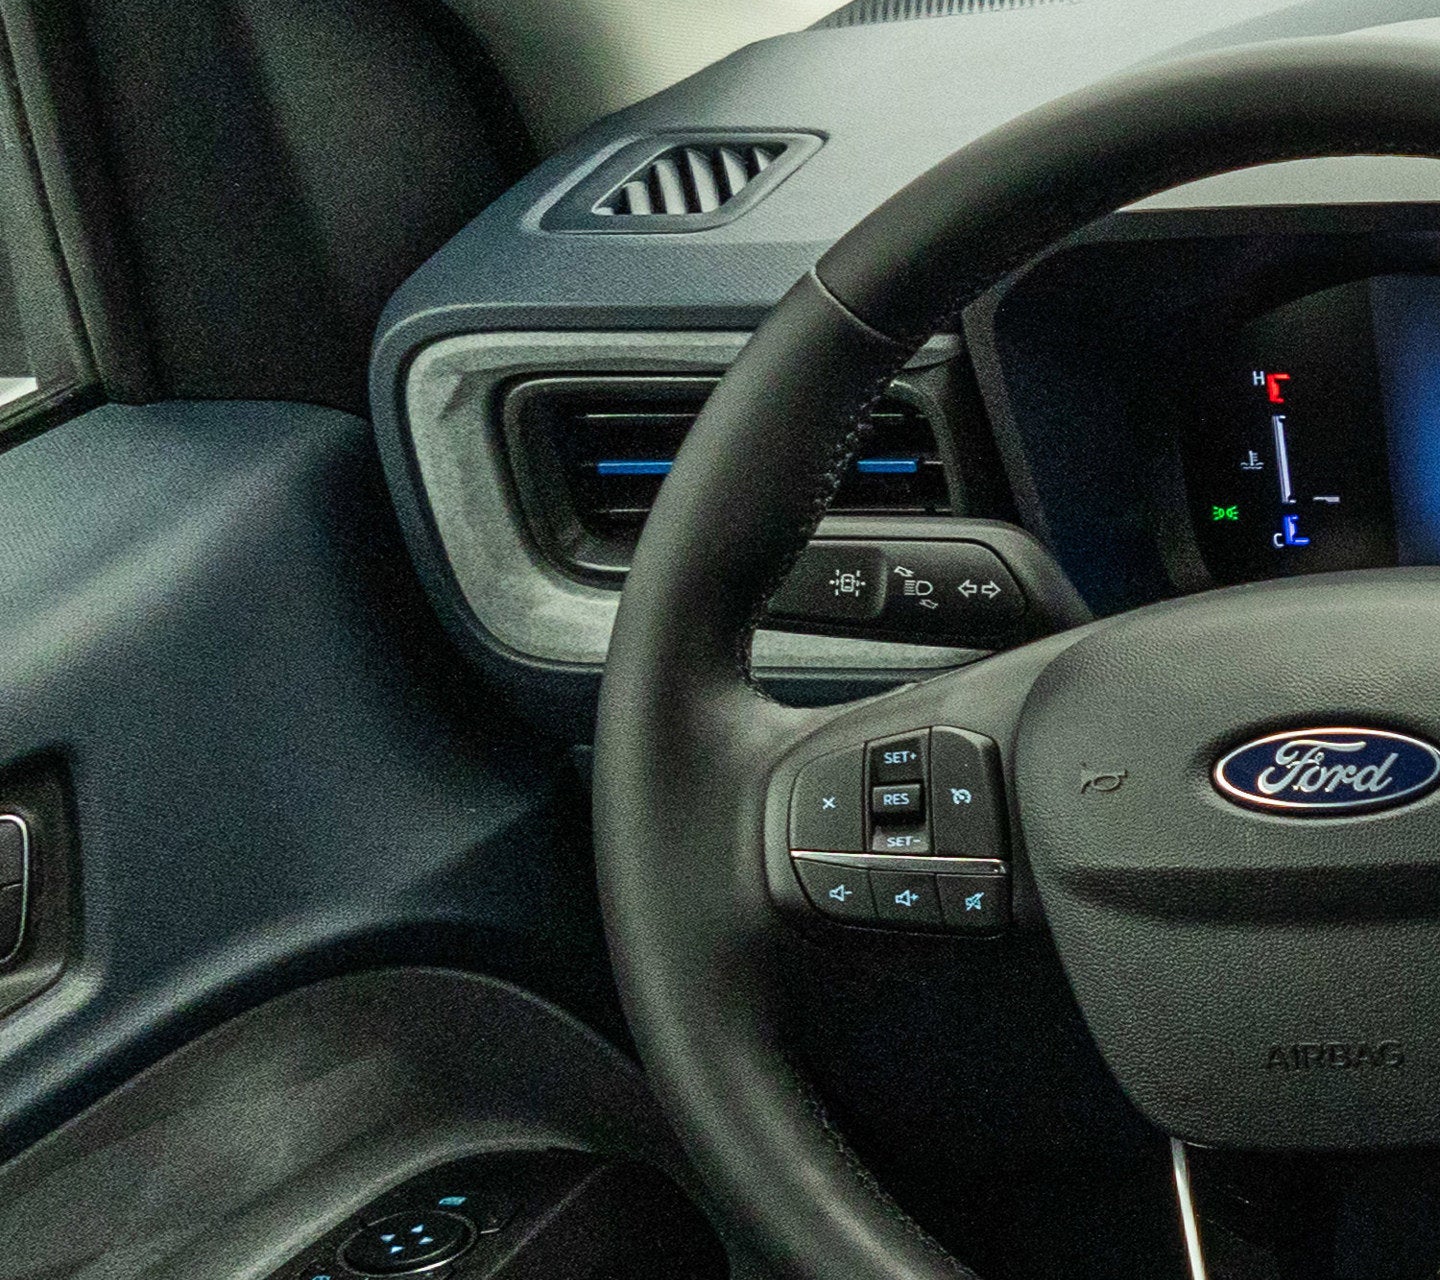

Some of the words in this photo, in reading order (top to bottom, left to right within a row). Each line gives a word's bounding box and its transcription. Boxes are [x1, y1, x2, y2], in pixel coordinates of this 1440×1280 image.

[1252, 370, 1265, 386] H
[1272, 532, 1285, 548] C
[1257, 738, 1400, 795] Ford
[883, 793, 910, 806] RES
[1266, 1039, 1404, 1069] AIRBAG
